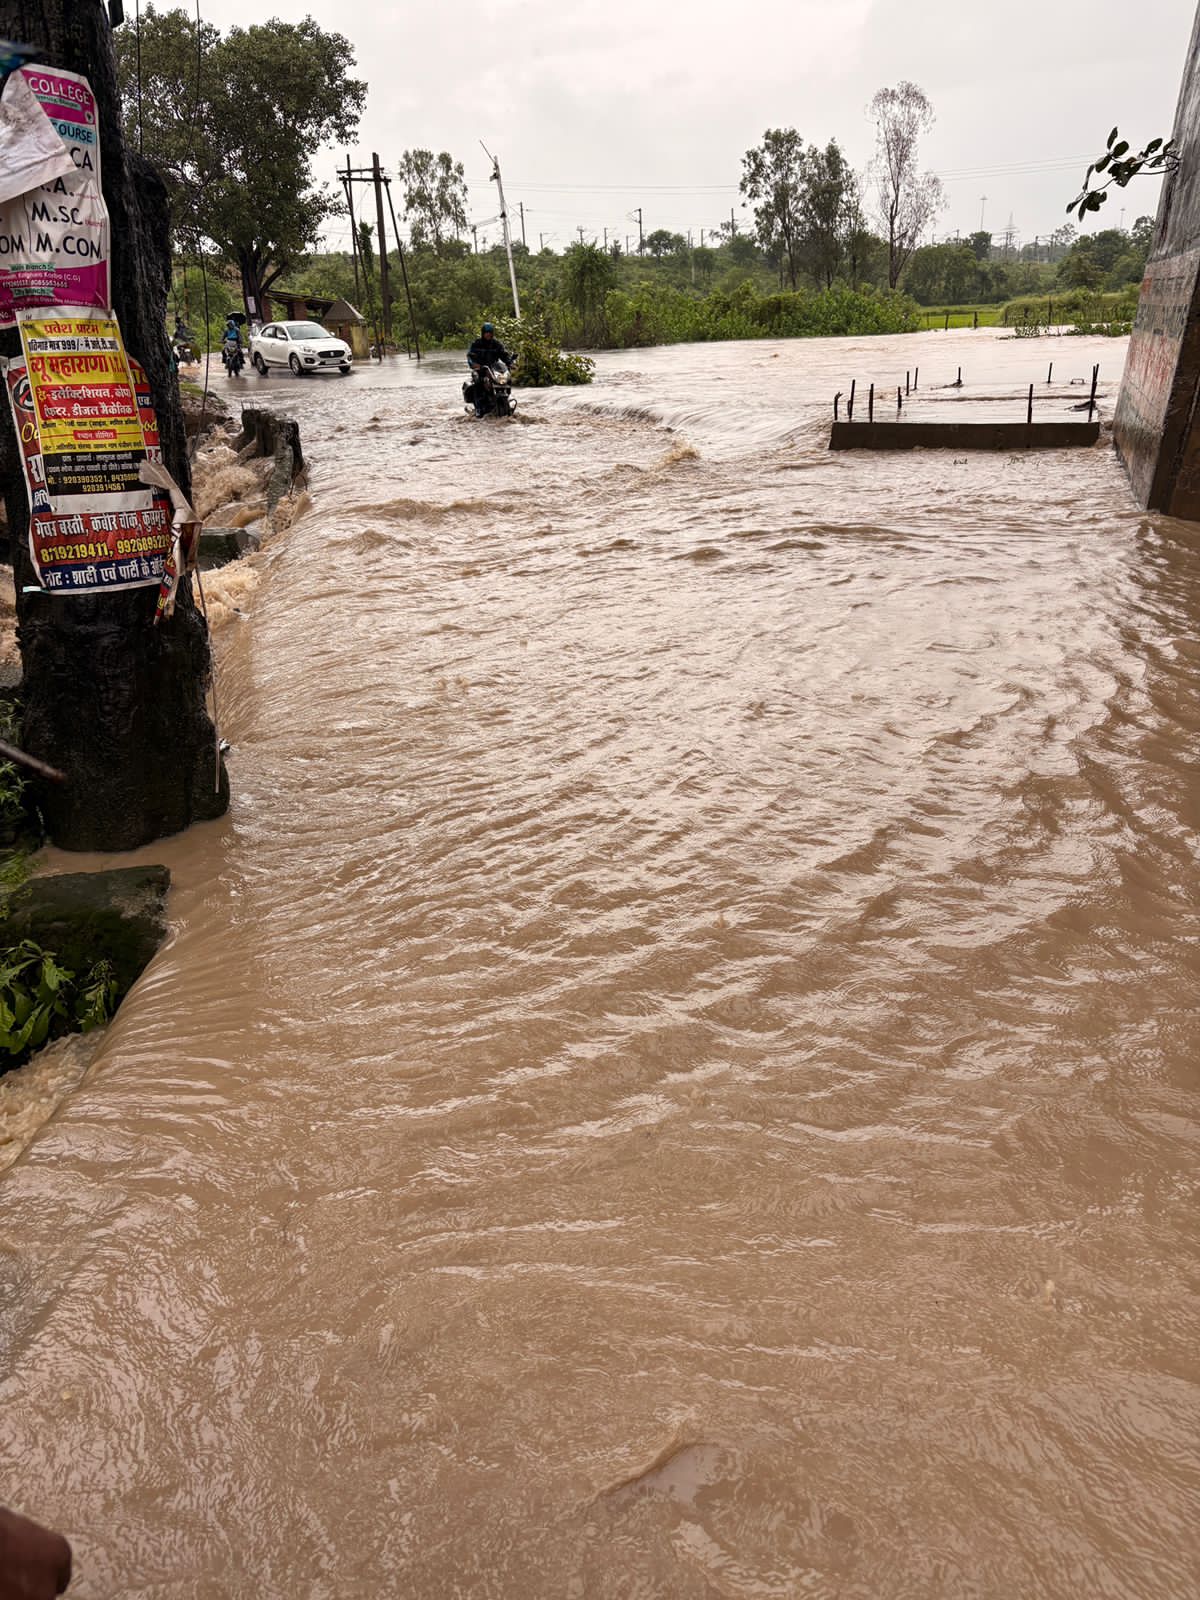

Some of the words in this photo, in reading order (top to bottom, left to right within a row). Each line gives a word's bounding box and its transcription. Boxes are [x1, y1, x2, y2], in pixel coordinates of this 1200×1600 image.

[28, 77, 91, 105] COLLEGE
[70, 147, 94, 171] CA
[40, 176, 75, 197] .A.
[32, 202, 83, 225] M.SC
[72, 402, 99, 416] डीजल
[90, 512, 119, 532] कबीर
[72, 565, 99, 585] शादी
[100, 563, 118, 582] एवं
[118, 560, 139, 580] पार्टी
[140, 557, 150, 578] के
